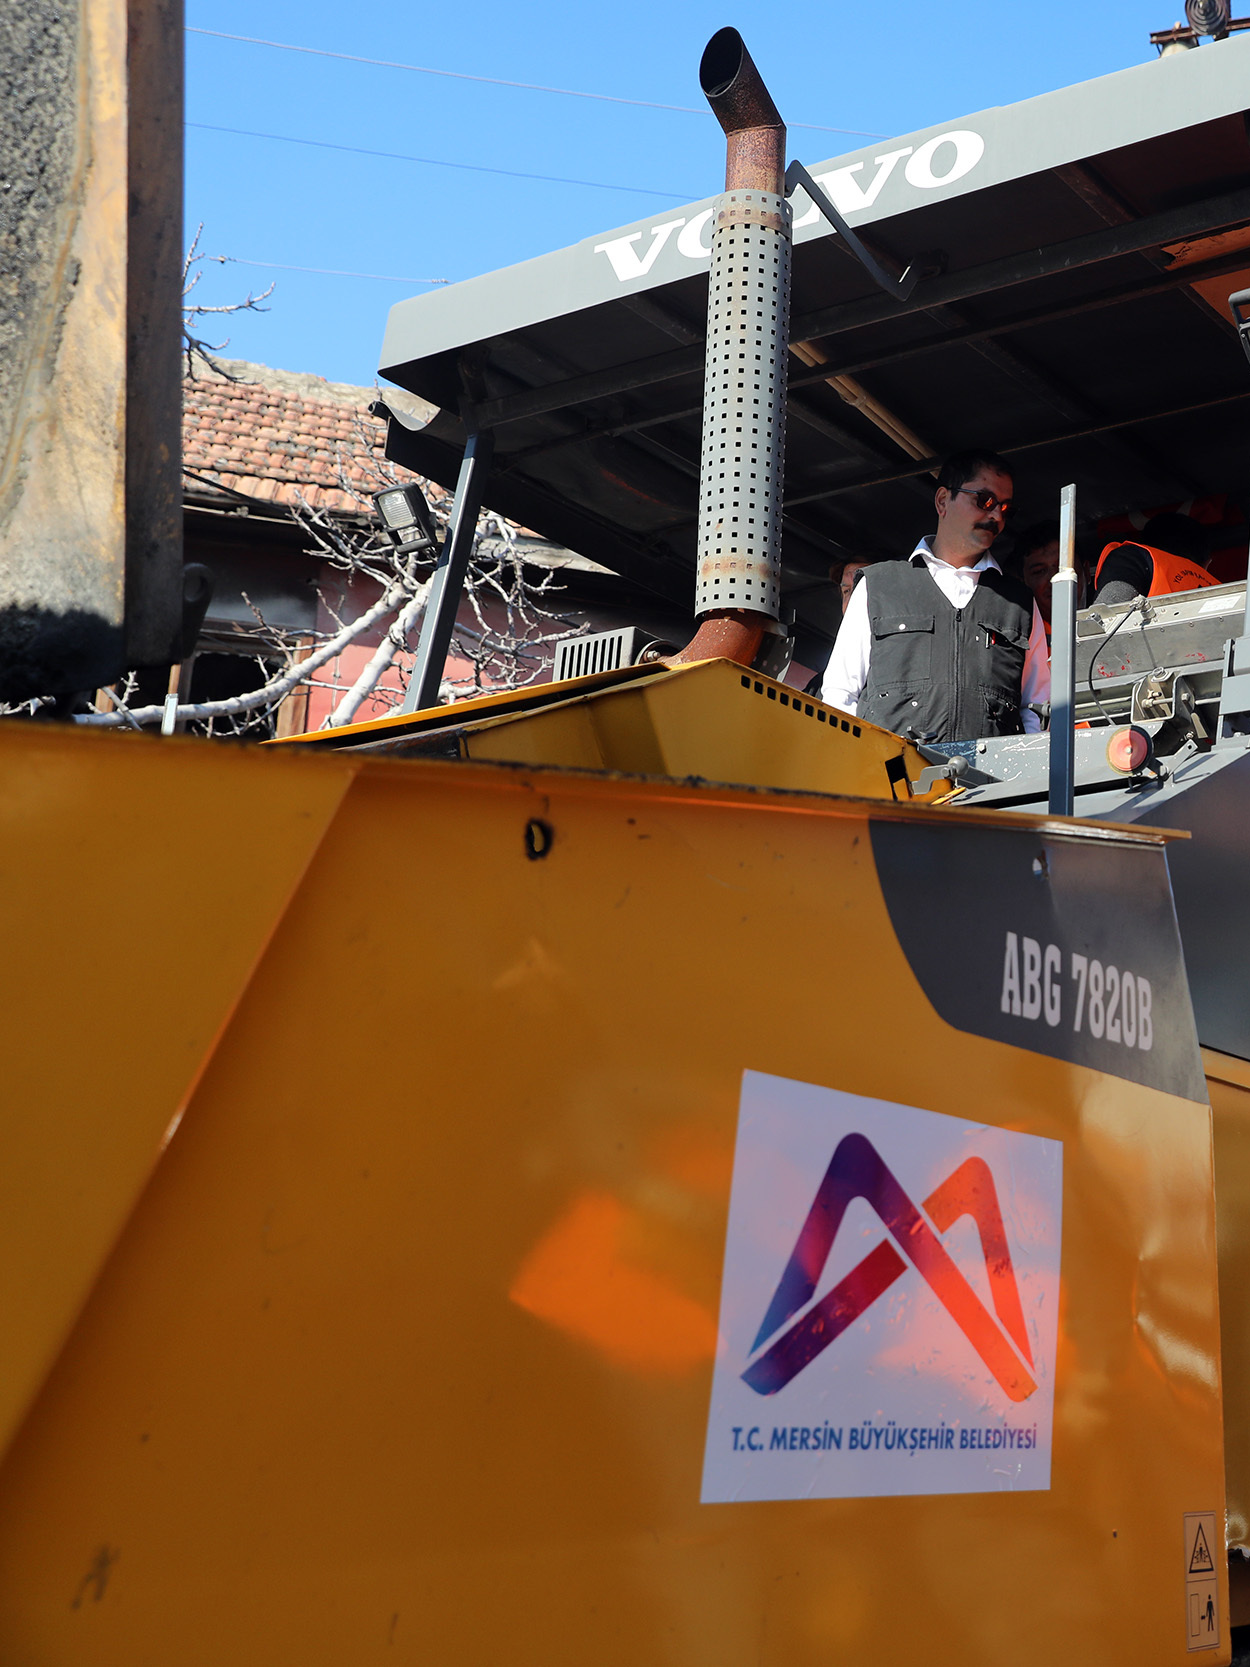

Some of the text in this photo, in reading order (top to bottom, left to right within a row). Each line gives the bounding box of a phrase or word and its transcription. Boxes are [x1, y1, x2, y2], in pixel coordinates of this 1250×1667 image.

[1001, 930, 1153, 1051] ABG 7820B
[732, 1419, 1037, 1456] T.C. MERSİN BÜYÜKŞEHİR BELEDİYESİ
